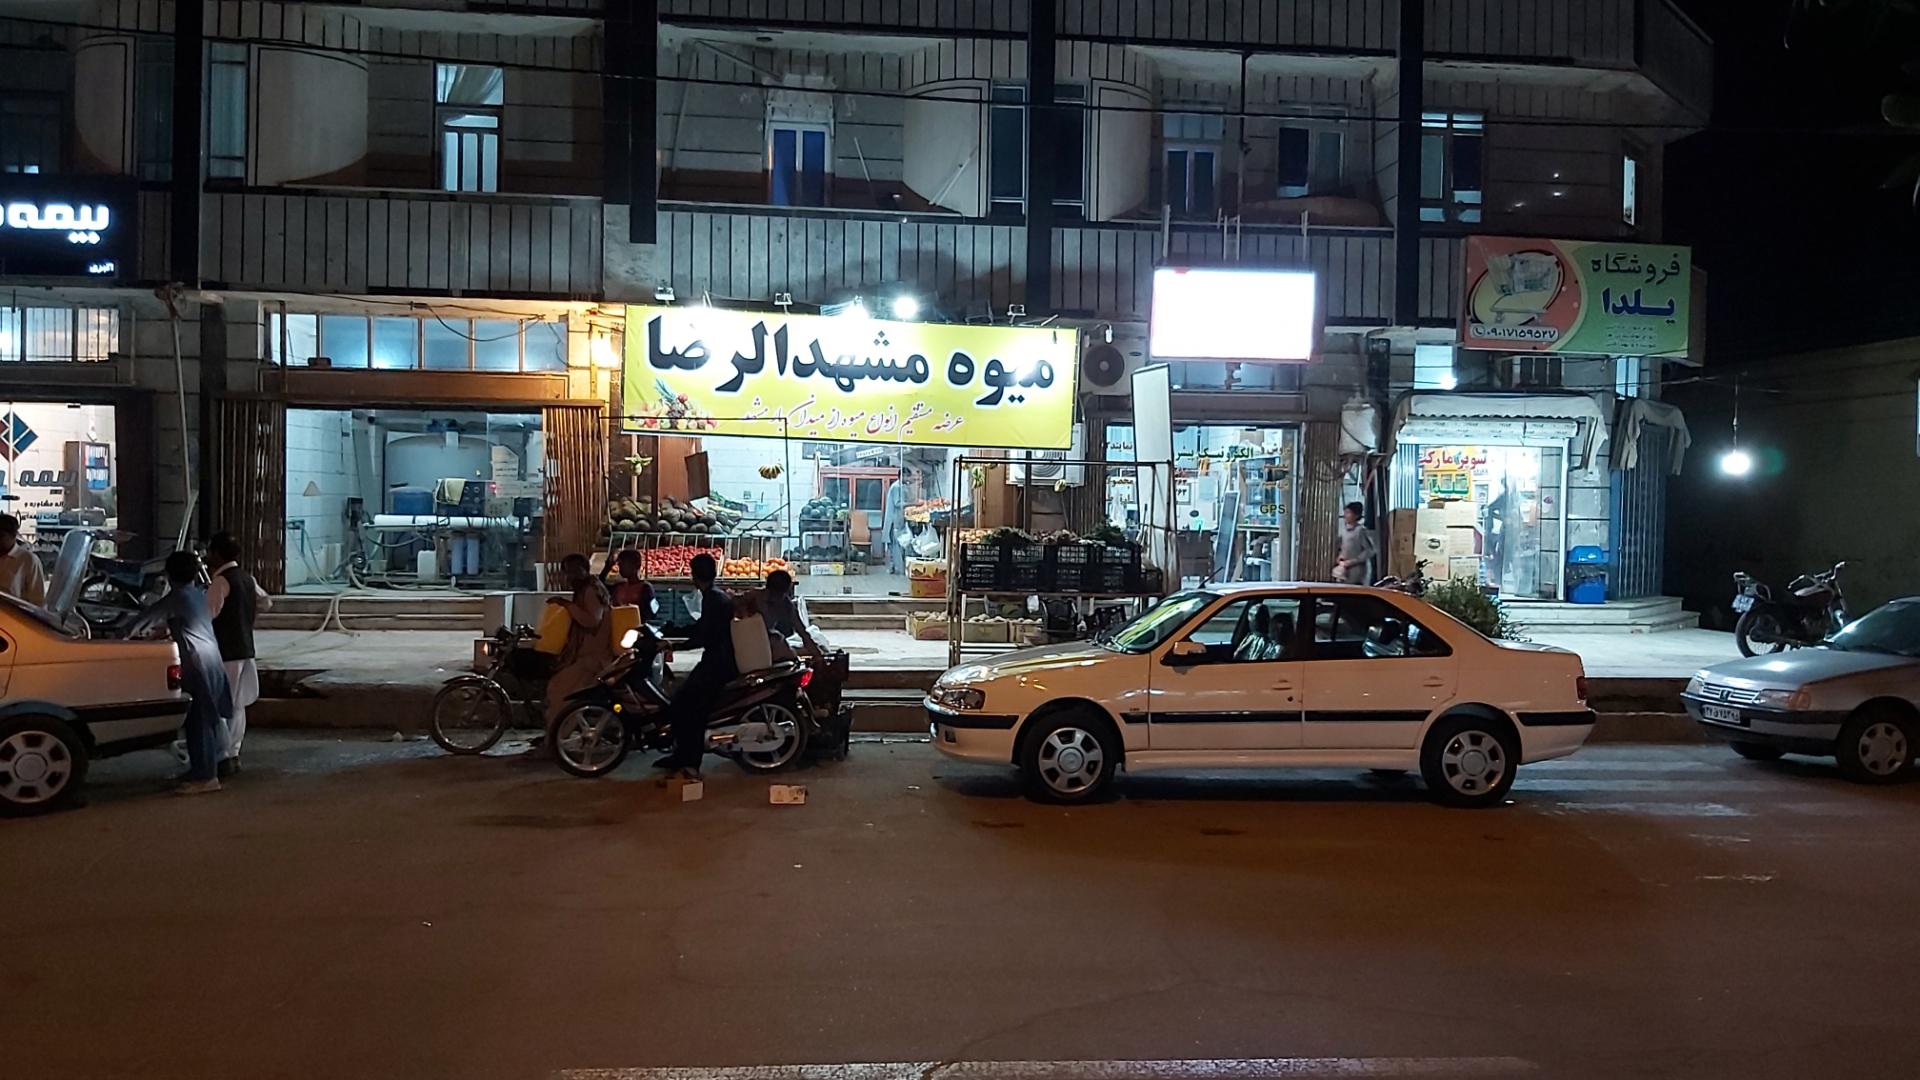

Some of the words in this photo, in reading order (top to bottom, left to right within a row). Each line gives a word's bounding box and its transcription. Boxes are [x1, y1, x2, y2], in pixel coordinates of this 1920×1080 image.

[7, 203, 110, 244] بیمه
[1591, 252, 1680, 285] فروشگاه
[1601, 287, 1675, 324] یلدا
[947, 348, 1056, 405] میوه
[827, 408, 840, 429] از
[841, 411, 865, 437] میوه
[866, 406, 897, 434] انواع
[899, 403, 932, 441] مستقیم
[933, 413, 963, 431] عرضه
[1105, 441, 1133, 452] نمایند
[1198, 446, 1254, 463] الکترونیک
[1459, 455, 1487, 470] سوپر
[1260, 504, 1286, 515] GPS
